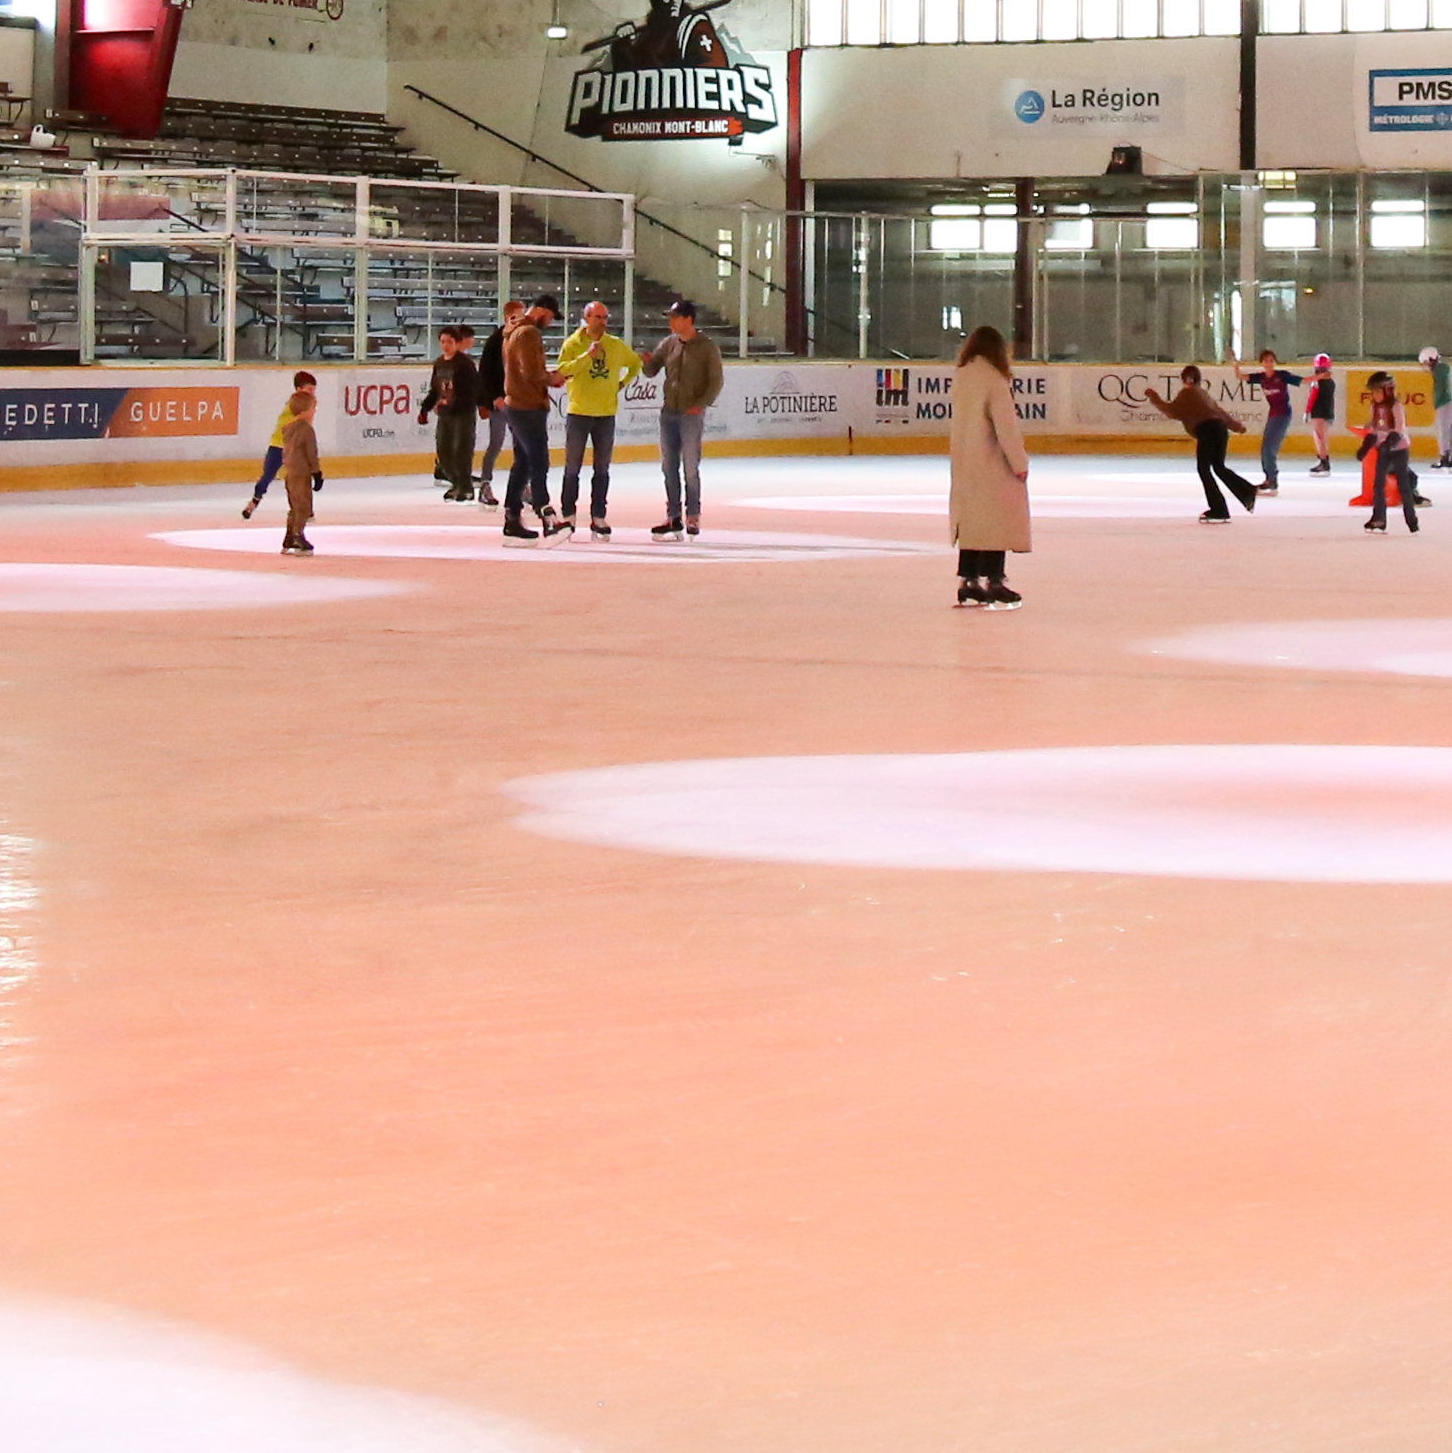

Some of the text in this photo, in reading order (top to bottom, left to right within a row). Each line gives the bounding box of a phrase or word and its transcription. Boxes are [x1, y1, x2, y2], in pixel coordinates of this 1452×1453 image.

[570, 66, 778, 126] PIONNIERS
[1051, 87, 1160, 112] La Région
[613, 119, 729, 135] CHAMONIX MONT-BLANC
[918, 377, 1045, 394] IMPRIE
[130, 400, 225, 422] GUELPA
[744, 392, 838, 414] LA POTINIÈRE
